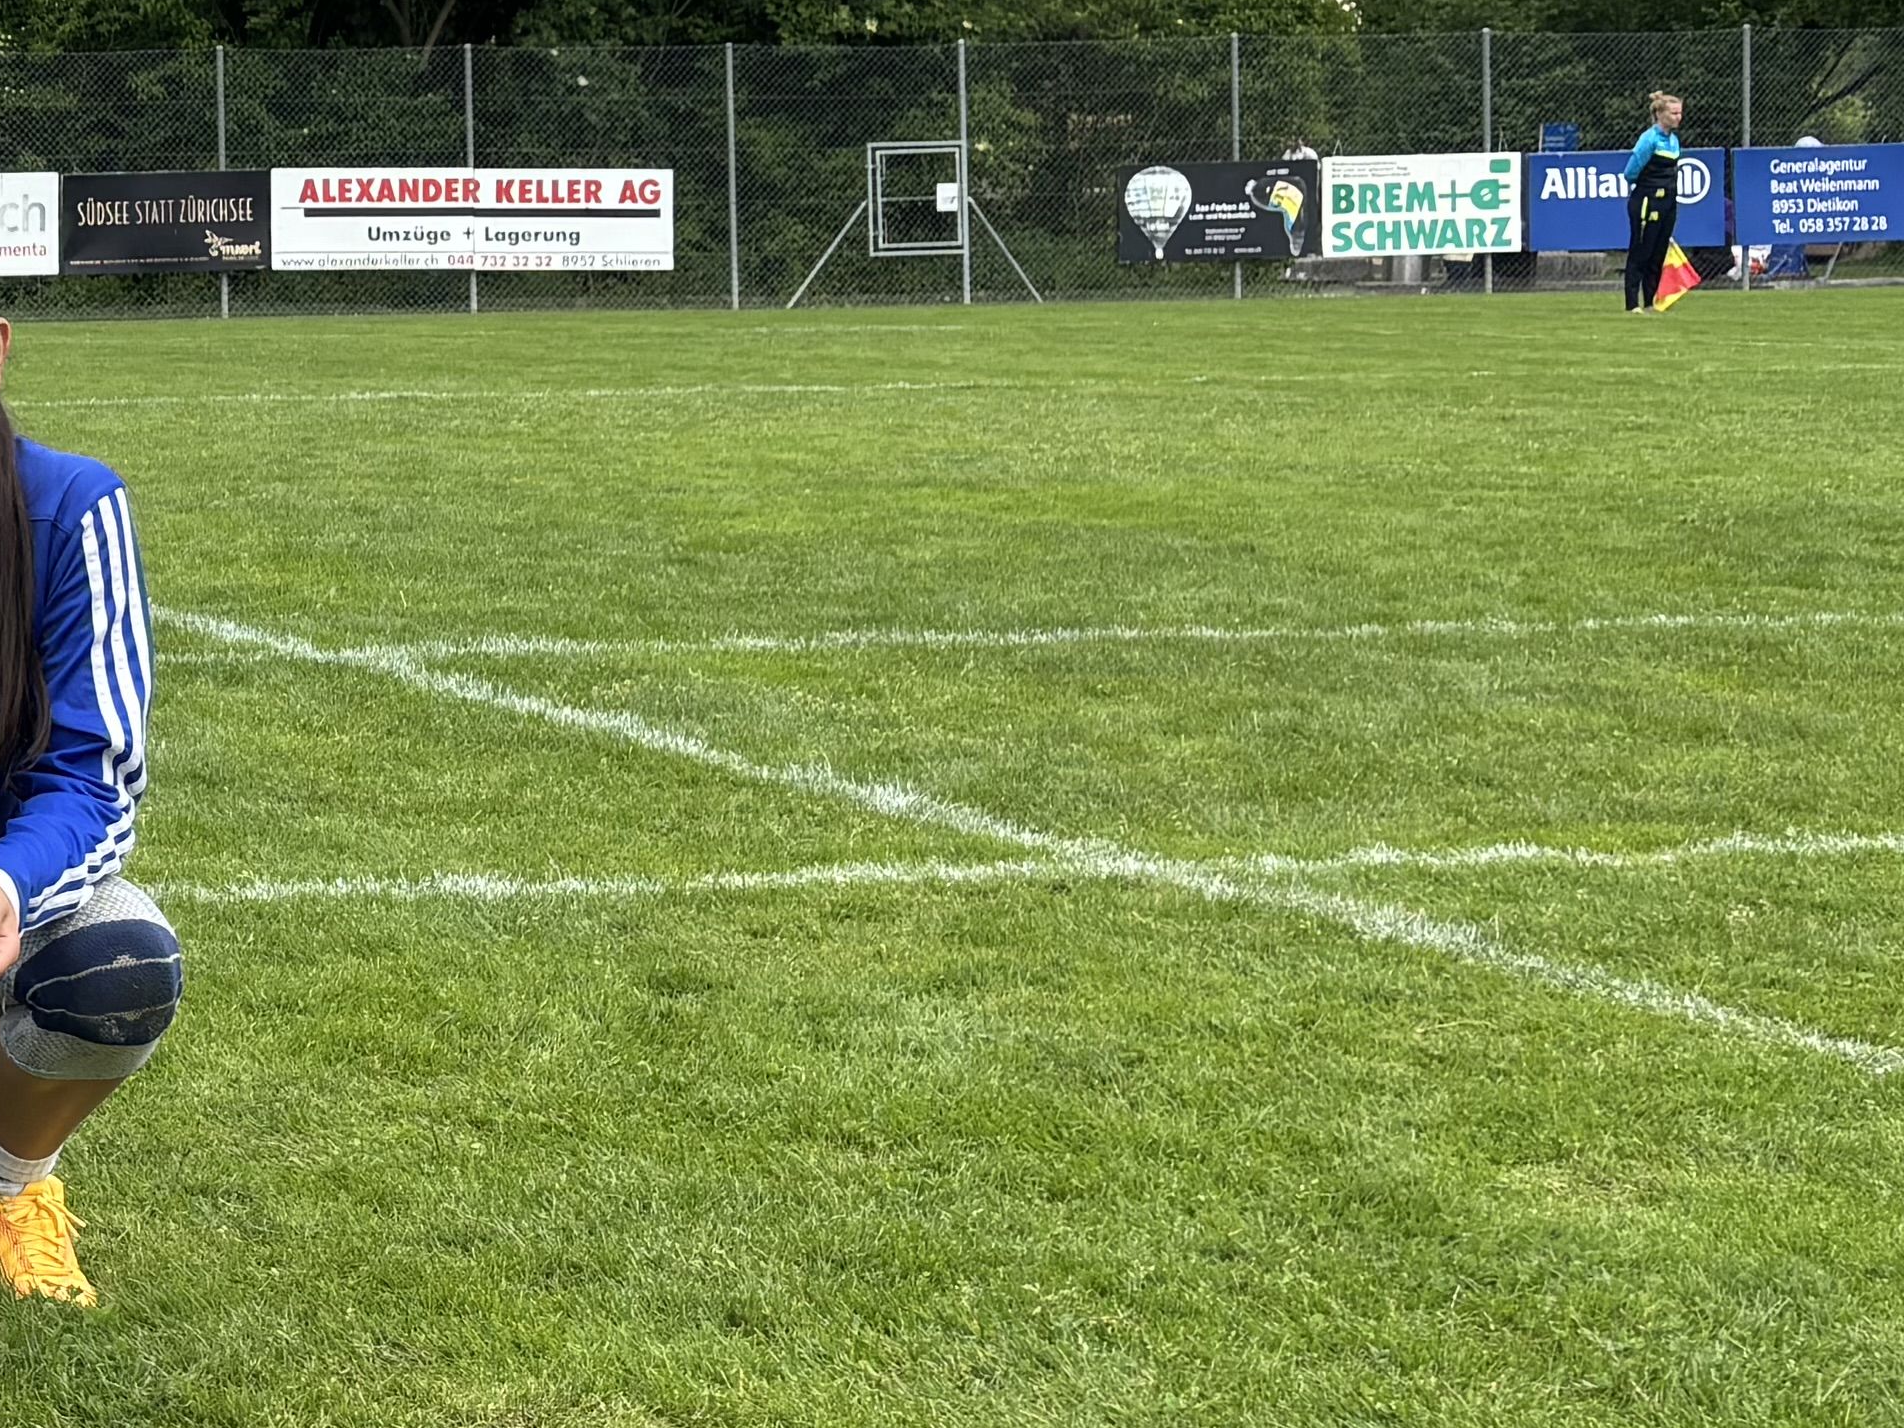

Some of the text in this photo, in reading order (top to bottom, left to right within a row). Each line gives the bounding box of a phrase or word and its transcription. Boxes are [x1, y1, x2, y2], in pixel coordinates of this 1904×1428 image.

[1770, 157, 1868, 176] Generalagentur
[298, 178, 662, 204] ALEXANDER KELLER AG
[1540, 166, 1637, 200] Allia
[1770, 176, 1881, 194] Beat Weilenmann
[1331, 181, 1437, 214] BREM
[1772, 196, 1859, 214] 8953 Dietikon
[77, 195, 254, 226] SÜDSEE STATT ZÜRICHSEE
[1331, 217, 1512, 252] SCHWARZ
[1773, 215, 1889, 234] Tel. 058 357 28 28
[367, 225, 452, 245] Umzüge
[484, 226, 582, 246] Lagerung
[447, 254, 475, 266] 044
[480, 255, 507, 267] 732
[512, 255, 530, 267] 32
[535, 255, 553, 267] 32
